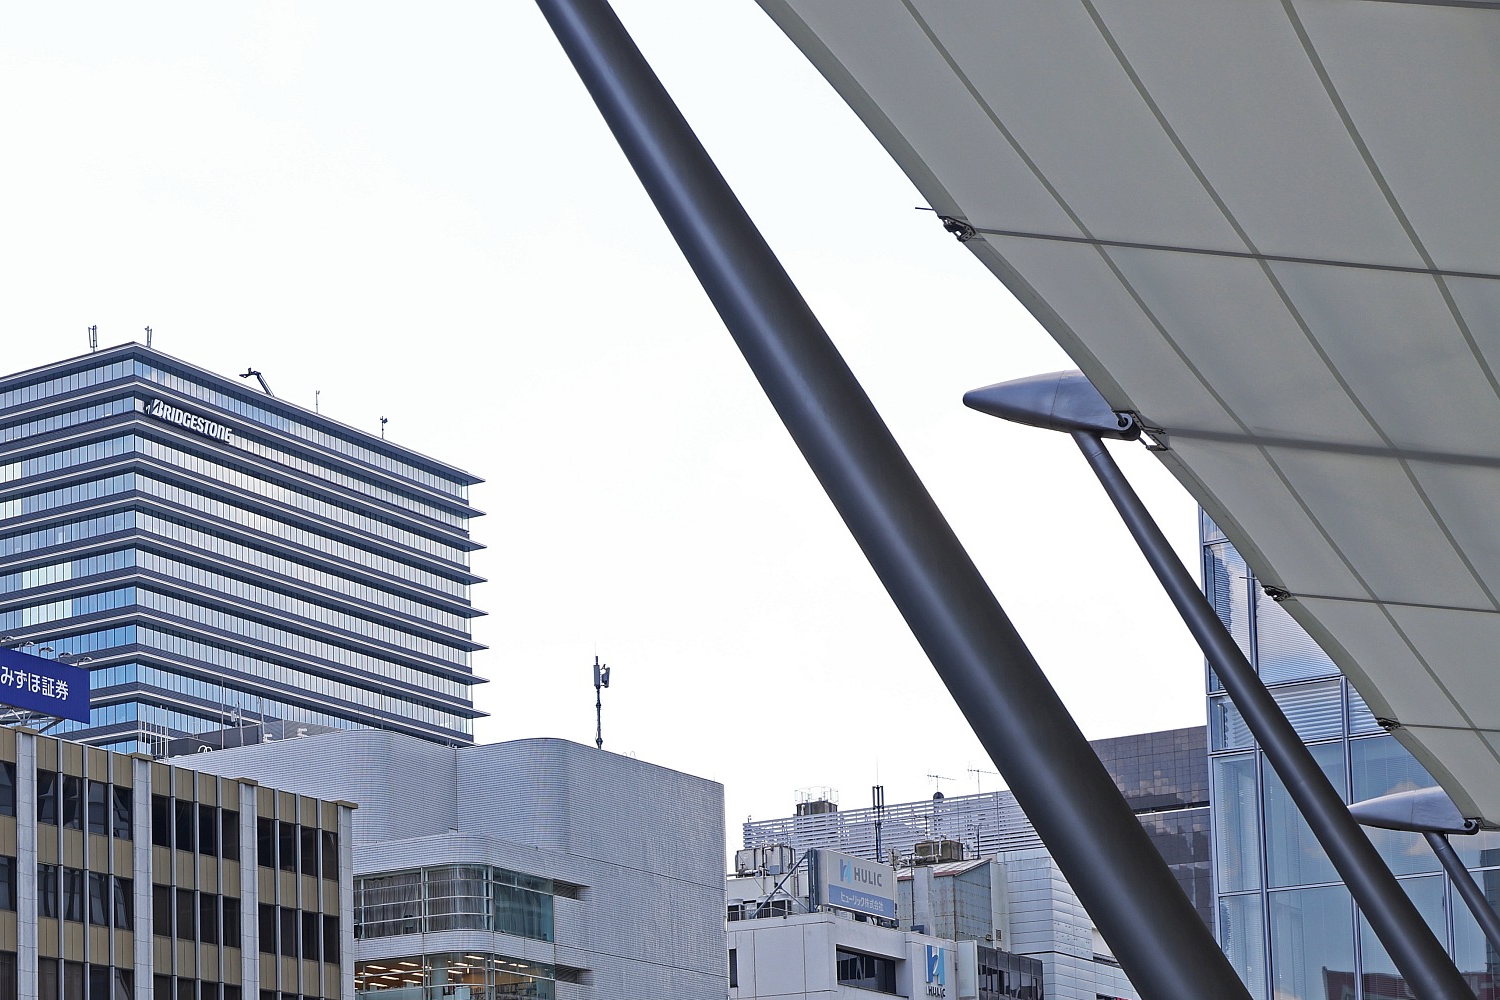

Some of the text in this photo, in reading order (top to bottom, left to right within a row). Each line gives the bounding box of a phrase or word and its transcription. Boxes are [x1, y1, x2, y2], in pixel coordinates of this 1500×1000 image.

[151, 398, 233, 444] BRIDGESTONE
[0, 665, 69, 701] みずほ証券
[853, 866, 883, 887] HULIC
[840, 890, 884, 911] ヒューリック株式会社
